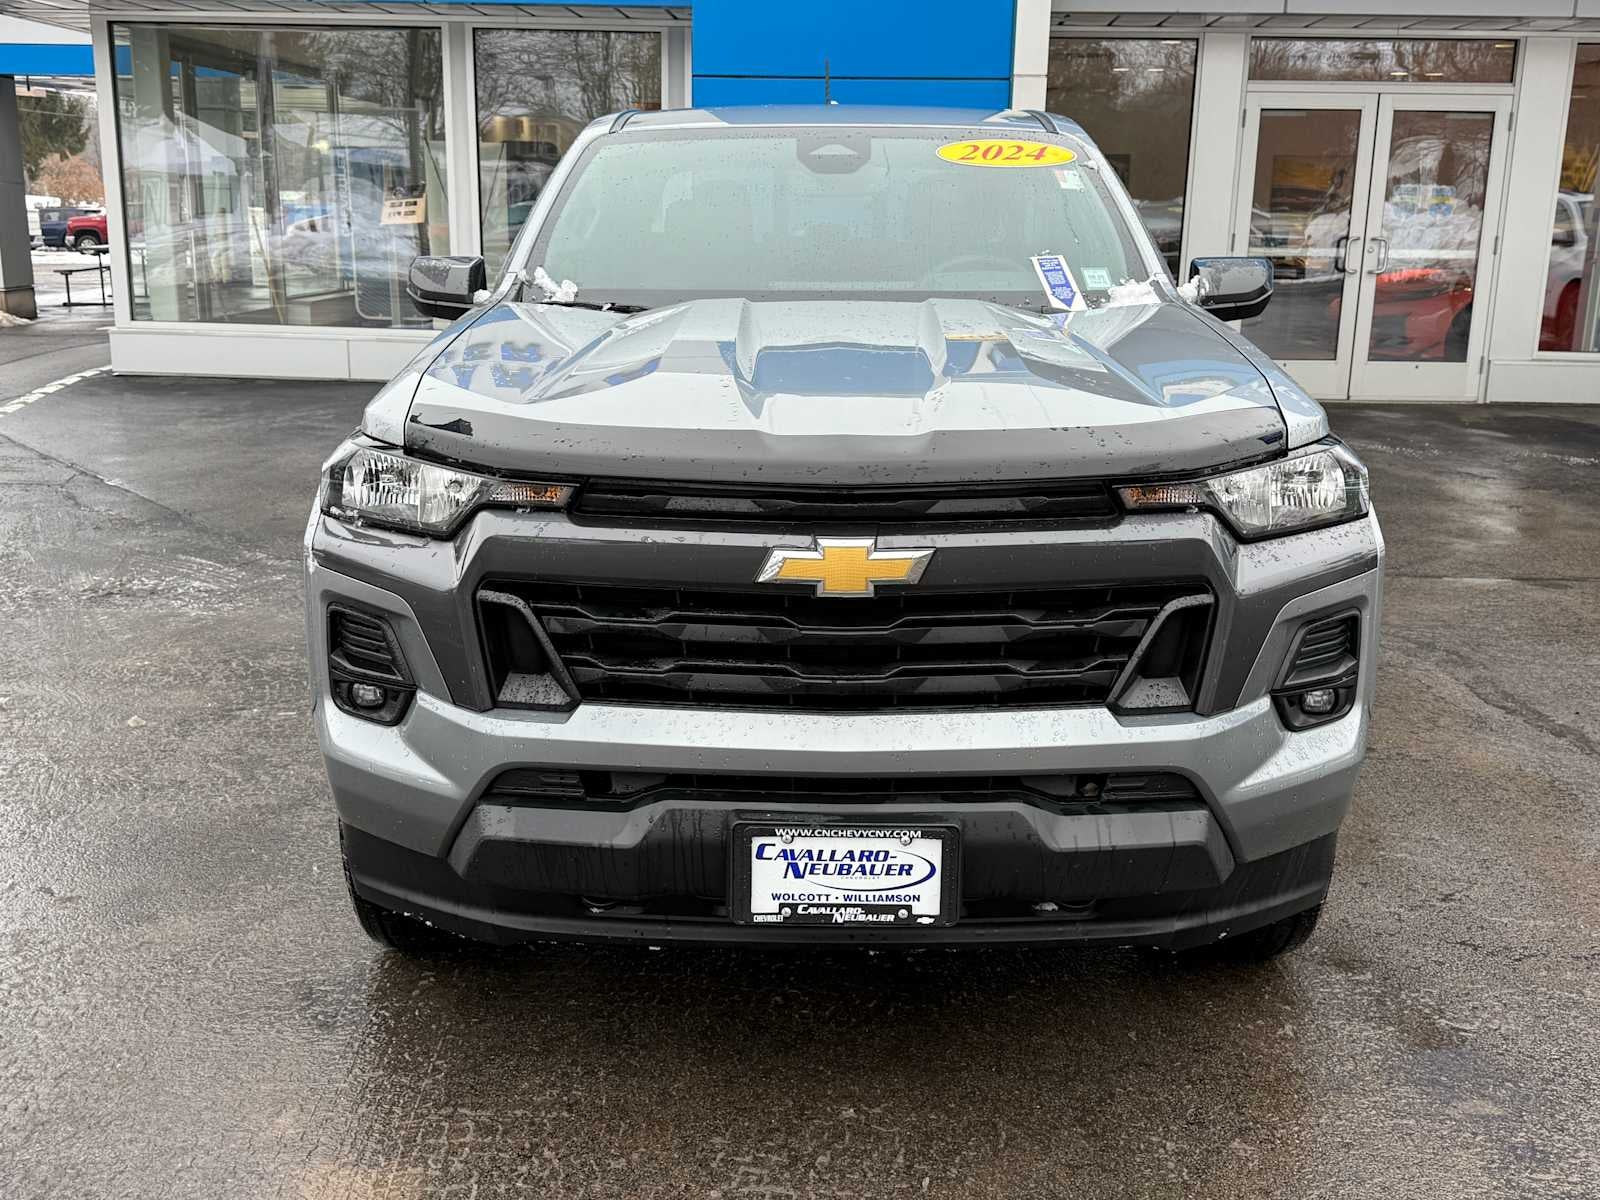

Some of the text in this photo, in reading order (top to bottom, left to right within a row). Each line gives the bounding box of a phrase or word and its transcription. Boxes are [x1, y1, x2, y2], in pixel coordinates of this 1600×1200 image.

[959, 144, 1049, 161] 2024
[775, 828, 922, 838] WWW.CNCHEVYCNY.COM
[755, 843, 898, 862] CAVALLARO-
[783, 862, 914, 879] NEUBAUER
[771, 893, 921, 903] WOLCOTT WILLIAMSON
[753, 914, 784, 922] CHEVROLET
[831, 911, 896, 923] NEUBAUER
